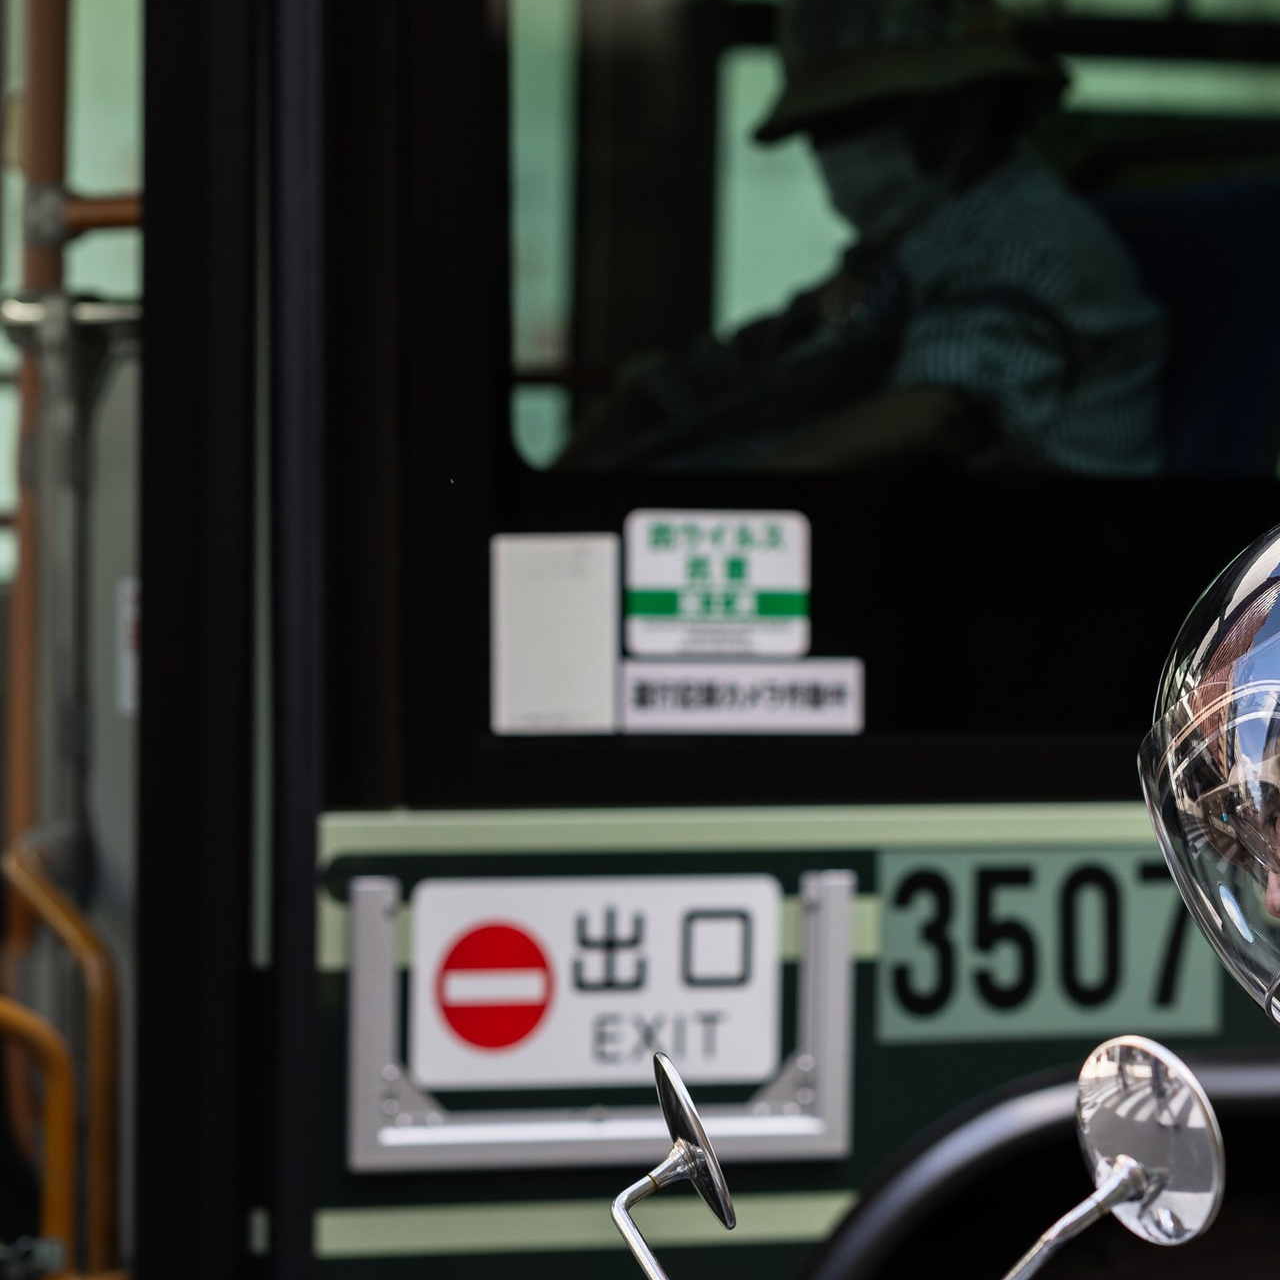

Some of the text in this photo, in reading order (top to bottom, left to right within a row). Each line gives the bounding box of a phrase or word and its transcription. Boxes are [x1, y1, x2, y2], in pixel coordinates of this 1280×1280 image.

[572, 906, 753, 992] 出口
[890, 864, 1192, 1019] 3507
[592, 1011, 728, 1064] EXIT
